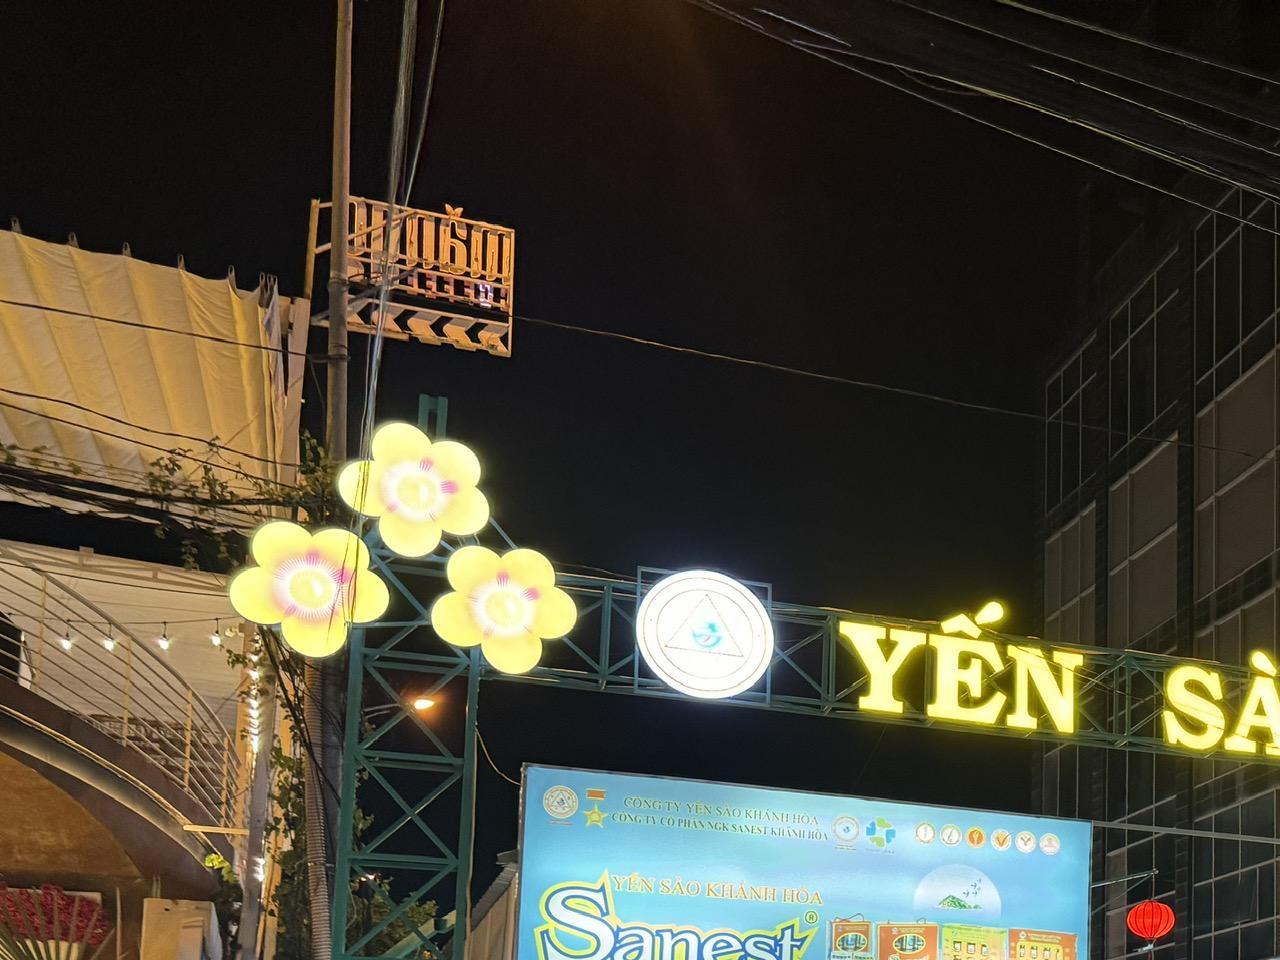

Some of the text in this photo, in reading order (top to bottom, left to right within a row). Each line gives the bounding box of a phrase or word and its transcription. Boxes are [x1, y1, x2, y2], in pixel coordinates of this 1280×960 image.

[837, 602, 1084, 735] YẾN
[611, 871, 823, 906] YẾN SÀO KHÁNH HÒA
